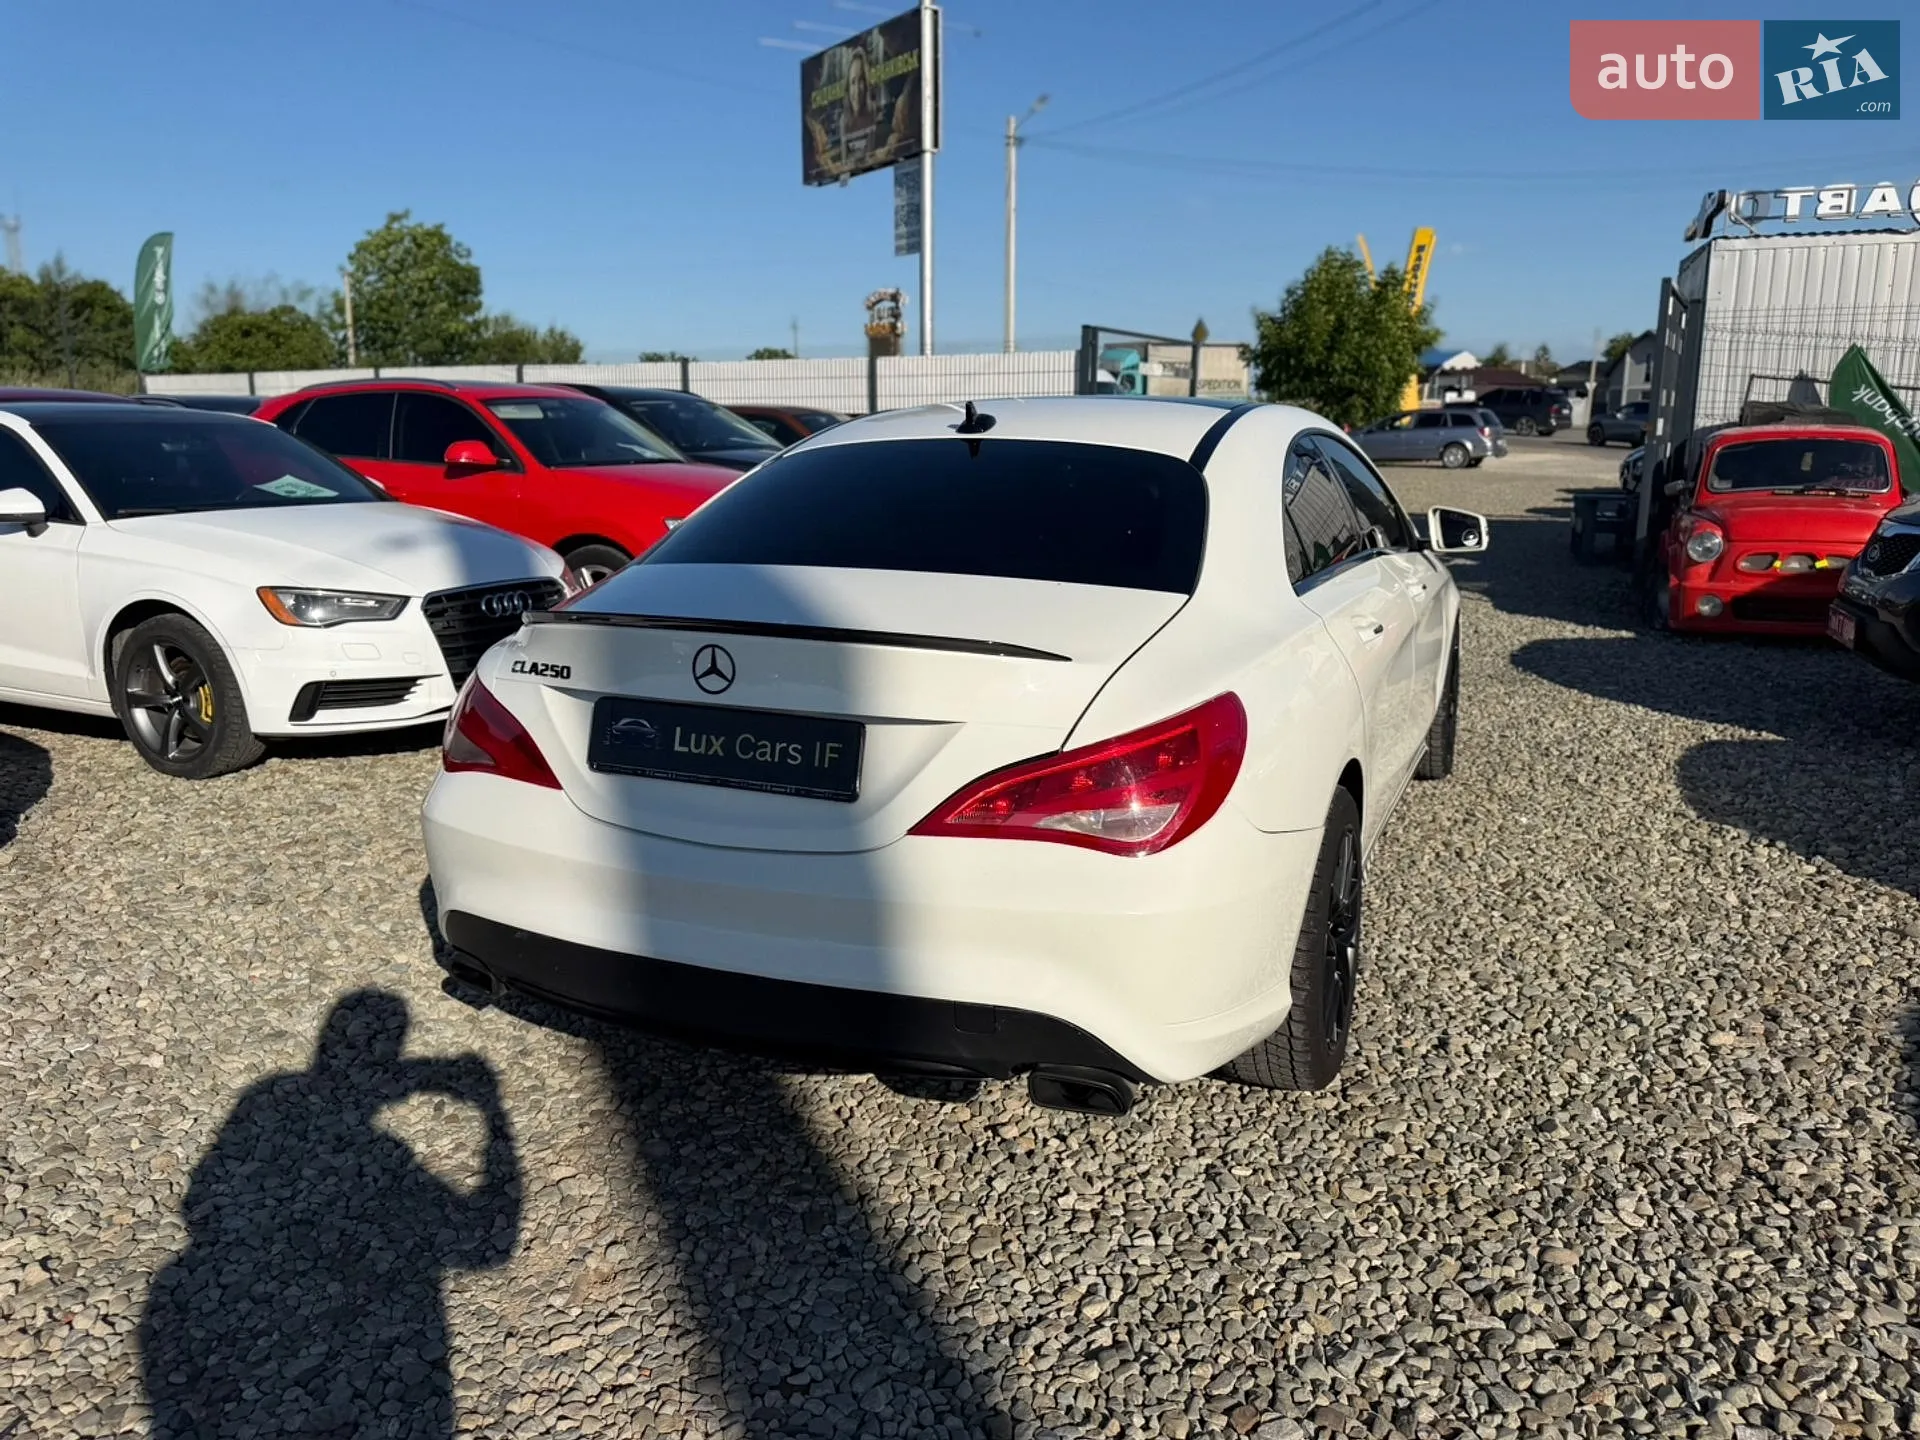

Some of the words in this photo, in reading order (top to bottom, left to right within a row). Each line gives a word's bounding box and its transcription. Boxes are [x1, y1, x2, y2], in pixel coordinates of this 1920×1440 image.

[511, 660, 571, 680] CLA250
[674, 726, 725, 757] Lux
[735, 734, 802, 765] Cars
[815, 742, 844, 769] IF
